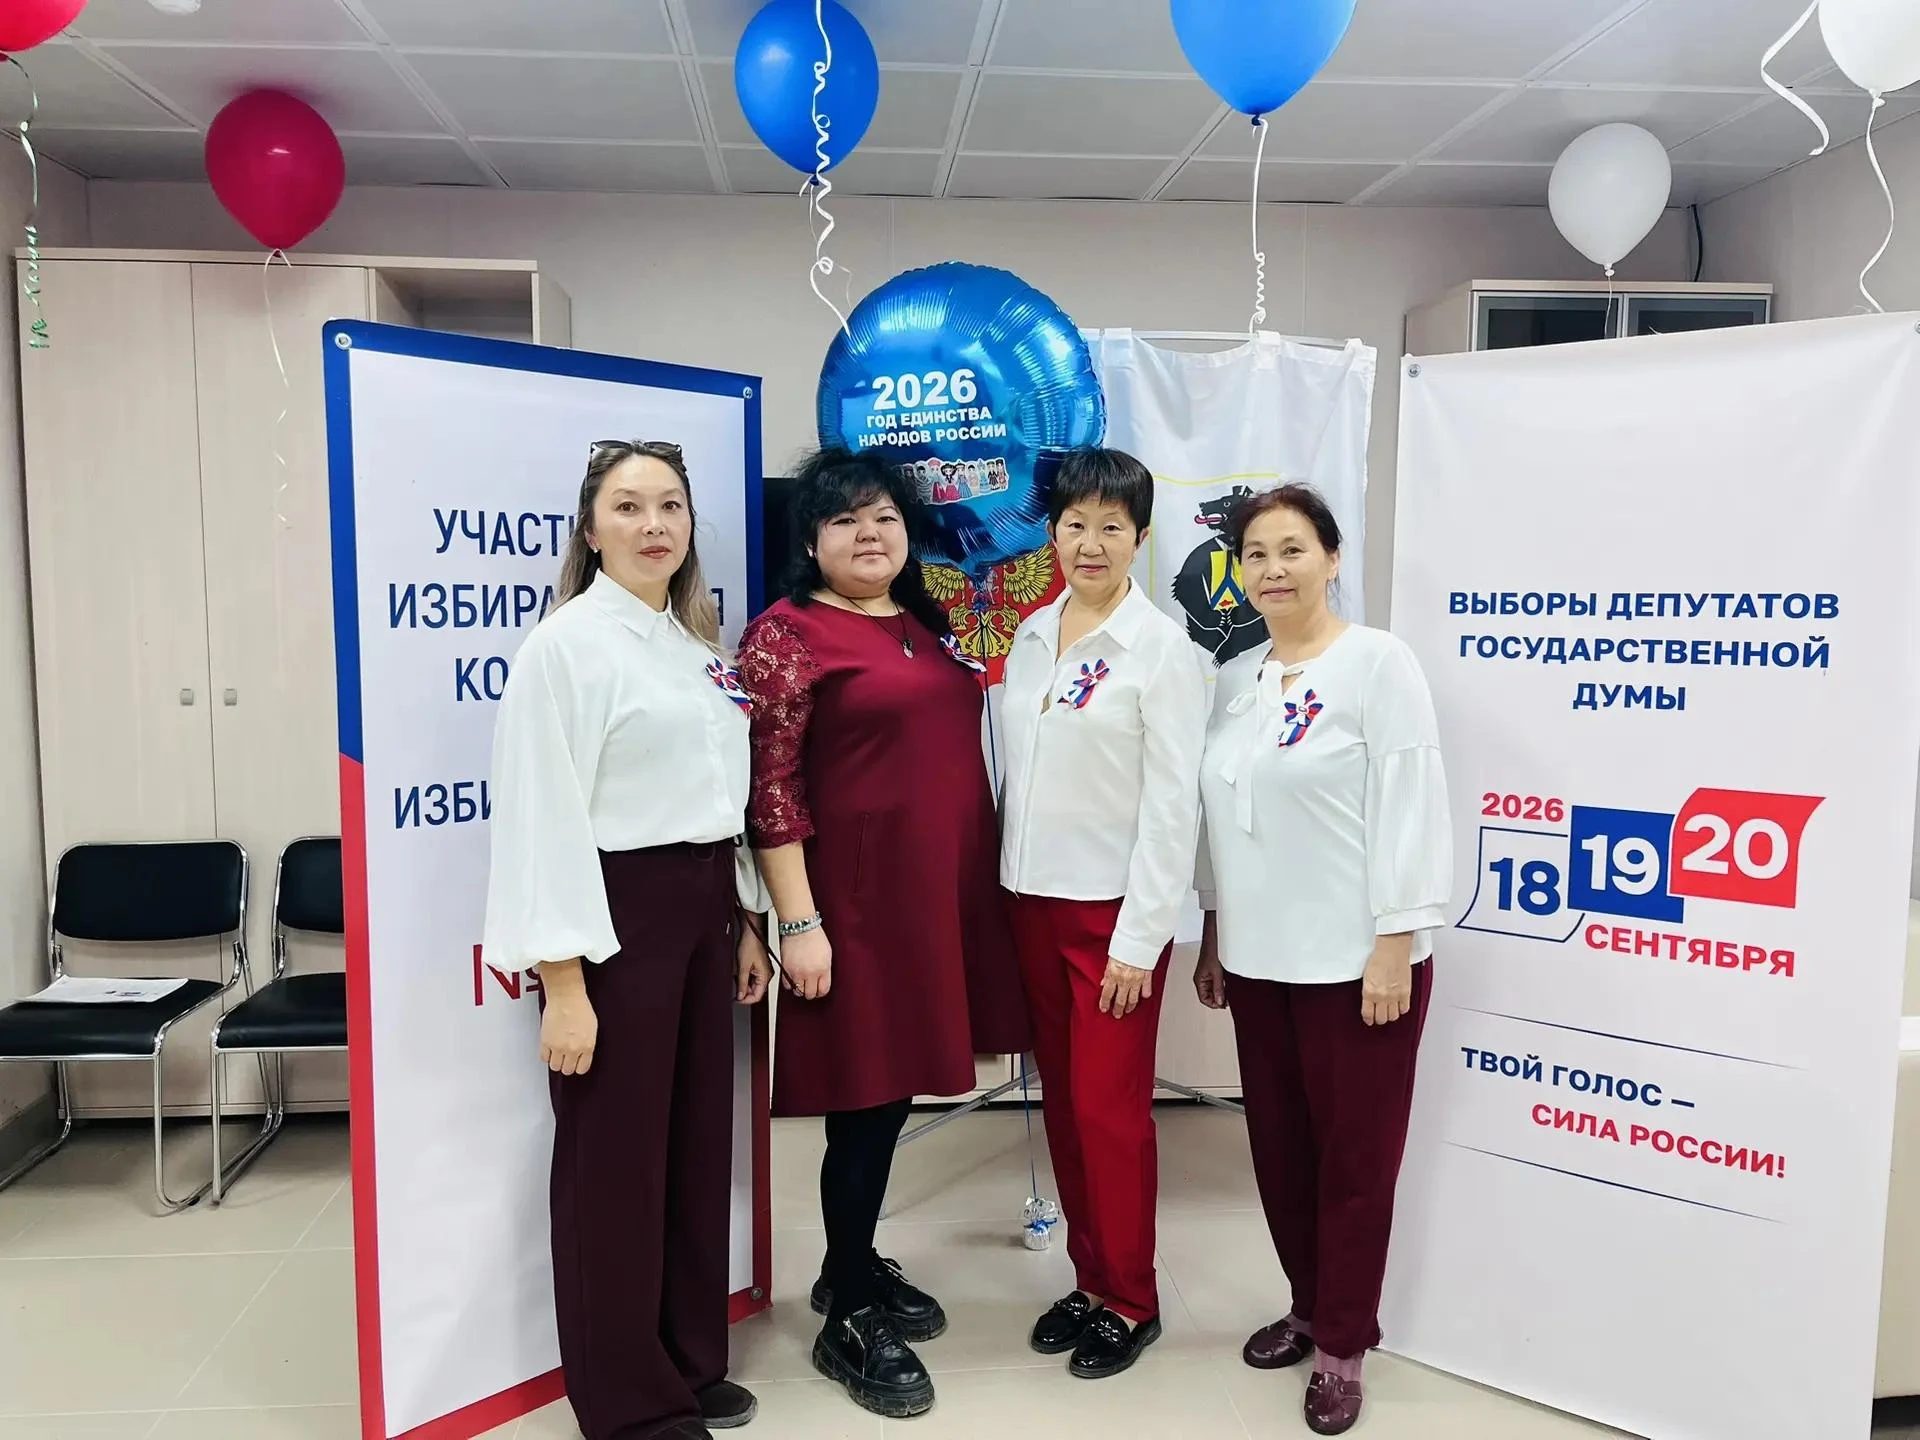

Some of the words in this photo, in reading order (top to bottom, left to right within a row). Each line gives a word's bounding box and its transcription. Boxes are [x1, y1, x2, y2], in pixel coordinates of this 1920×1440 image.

[872, 369, 977, 411] 2026
[858, 431, 931, 447] НАРОДОВ
[936, 423, 1007, 442] РОССИИ
[866, 414, 898, 429] ГОД
[901, 406, 992, 427] ЕДИНСТВА
[433, 508, 576, 557] УЧАСТ
[1449, 591, 1597, 616] ВЫБОРЫ
[1606, 592, 1840, 620] ДЕПУТАТОВ
[1459, 635, 1830, 669] ГОСУДАРСТВЕННОЙ
[1572, 682, 1686, 711] ДУМЫ
[1482, 792, 1564, 823] 2026
[1489, 857, 1561, 916] 18
[1581, 834, 1660, 896] 19
[1682, 813, 1790, 880] 20
[1584, 923, 1795, 978] СЕНТЯБРЯ
[1460, 1046, 1543, 1083] ТВОЙ
[1552, 1064, 1662, 1107] ГОЛОС
[1531, 1103, 1620, 1143] СИЛА
[1629, 1123, 1786, 1179] РОССИИ!
